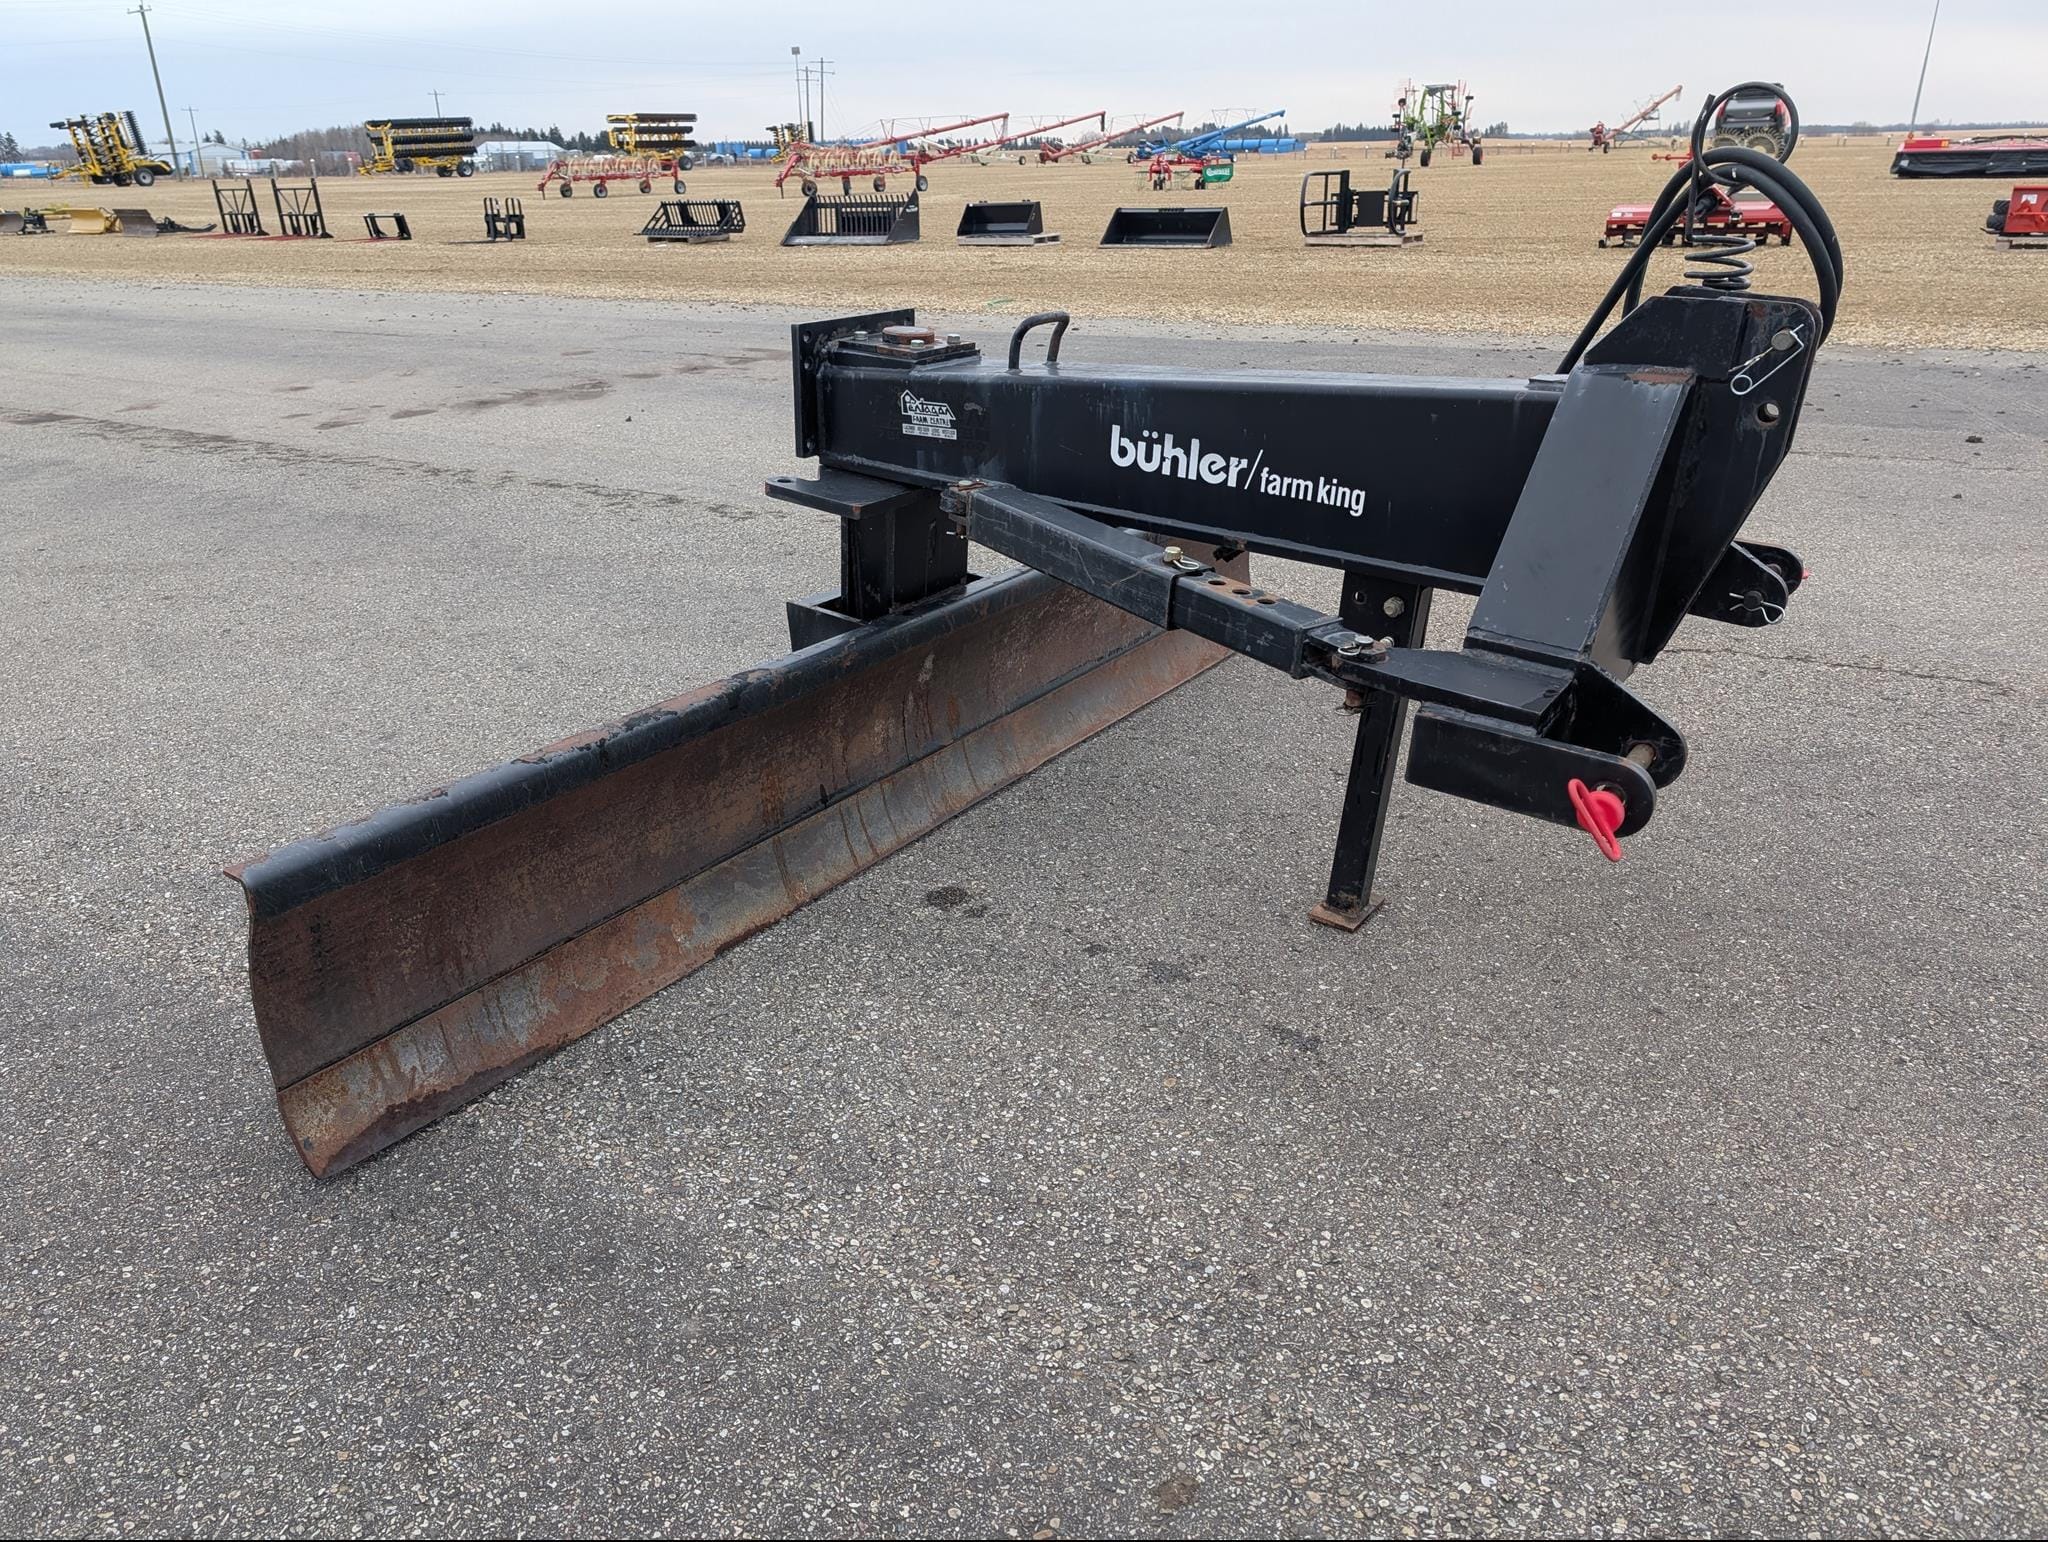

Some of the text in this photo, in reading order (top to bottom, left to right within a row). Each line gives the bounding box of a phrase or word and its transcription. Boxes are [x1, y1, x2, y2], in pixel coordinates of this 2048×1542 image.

[1110, 424, 1365, 517] bühler farm king
